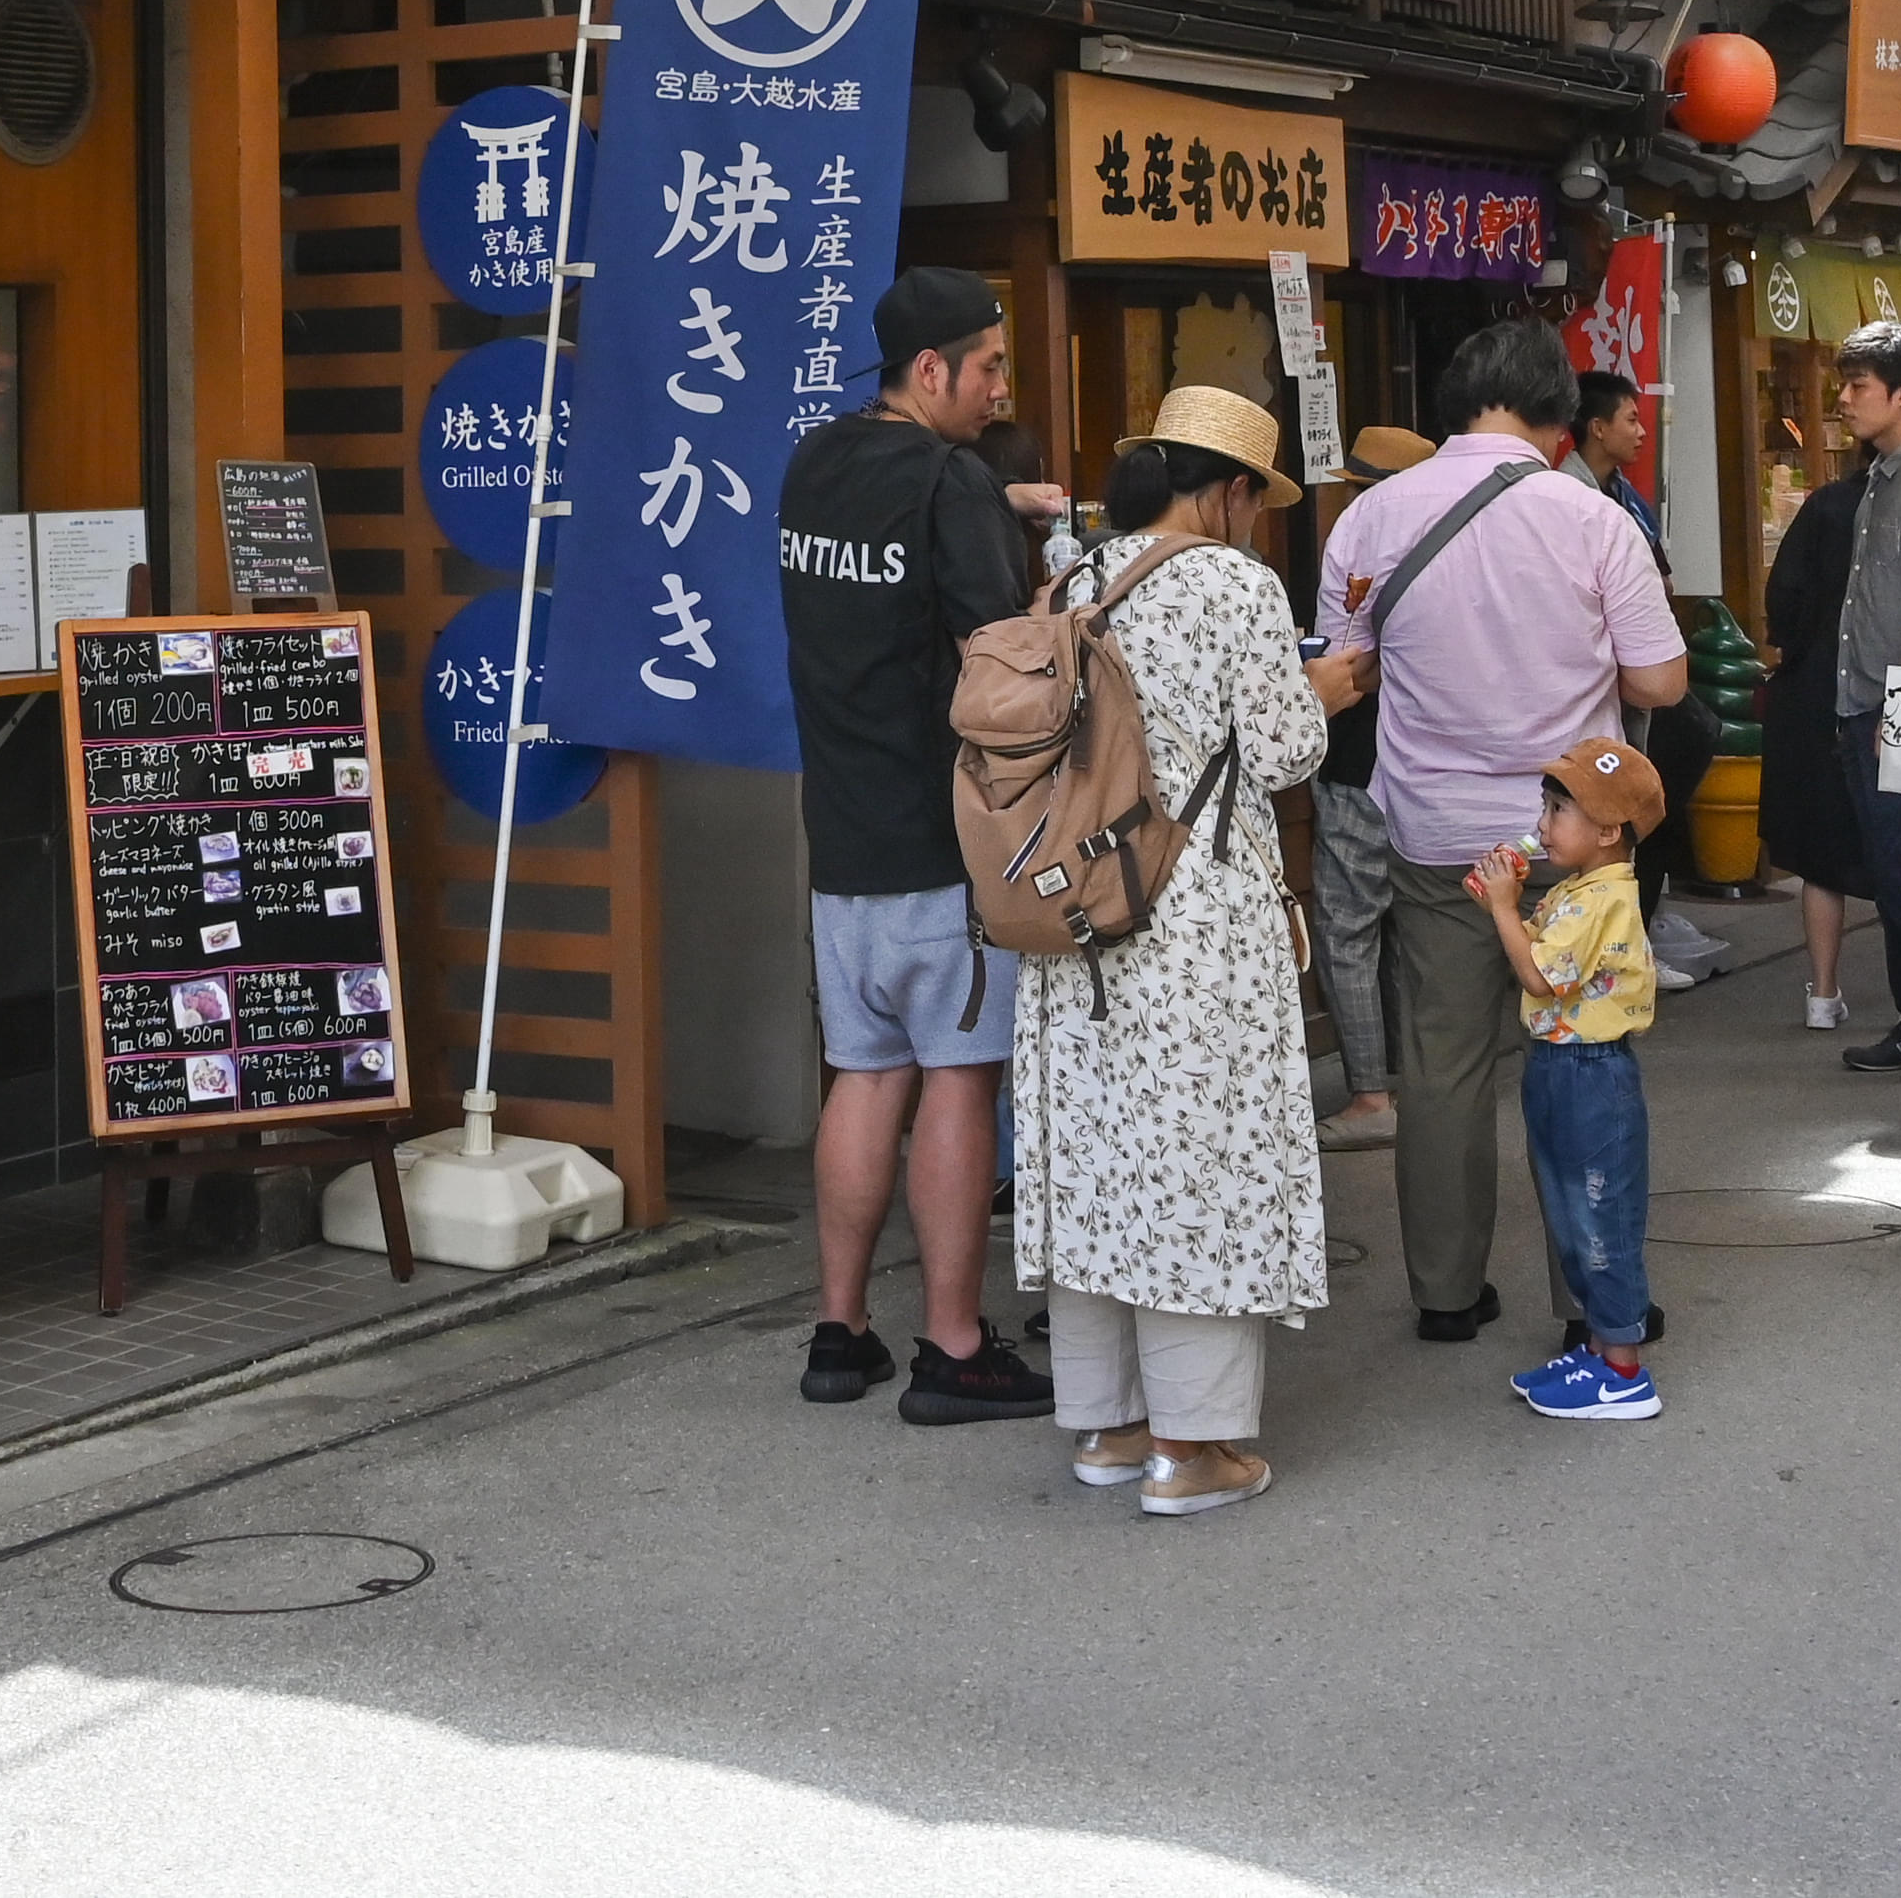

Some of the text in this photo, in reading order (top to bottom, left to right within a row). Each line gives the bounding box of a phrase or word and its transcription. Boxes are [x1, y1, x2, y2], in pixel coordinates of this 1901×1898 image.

[654, 67, 862, 112] 宮島・大越水産
[1095, 129, 1328, 230] 生産者のお店
[481, 224, 548, 256] 宮島産
[468, 258, 554, 288] かき使用
[640, 140, 792, 701] 焼きかき
[441, 464, 508, 489] Grilled
[77, 637, 152, 670] 焼かき
[291, 656, 326, 672] combo
[80, 672, 163, 697] grilled oyster
[94, 691, 212, 731] 1個 200円
[242, 696, 339, 728] 1皿 500円
[453, 720, 504, 743] Fried
[93, 747, 170, 770] 土・日・祝日
[209, 772, 301, 794] 1皿 600円
[89, 810, 324, 843] トッピング焼かき 1個 300円
[131, 862, 147, 875] and
[253, 857, 266, 871] oil
[106, 906, 176, 924] garlic butter
[256, 902, 321, 922] gratin style
[103, 932, 183, 957] みそ miso
[100, 984, 151, 1001] あつあつ
[112, 997, 169, 1018] かきフライ
[238, 1006, 271, 1018] oyster
[105, 1016, 167, 1030] fried oyster
[324, 1017, 367, 1036] 600円
[182, 1026, 225, 1045] 500円
[107, 1061, 173, 1085] かきピザ
[114, 1096, 187, 1119] 1枚 400円
[250, 1085, 329, 1108] 1皿 600円
